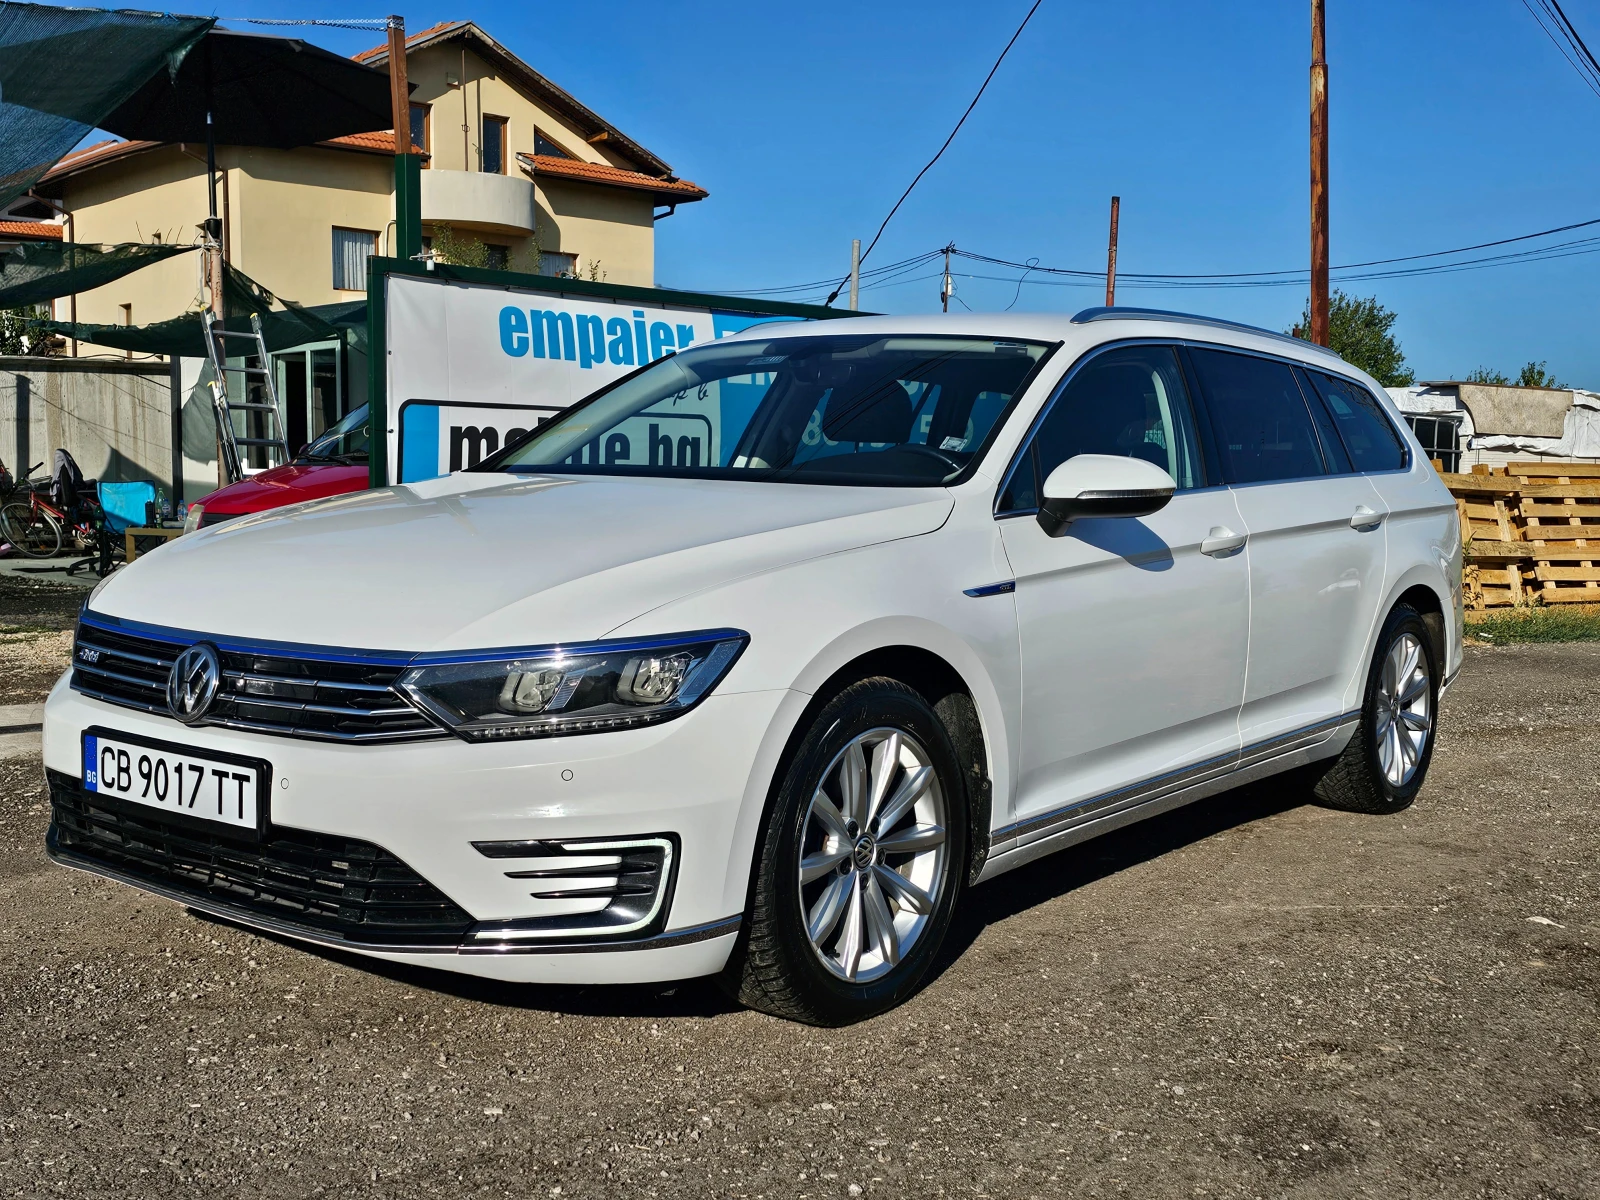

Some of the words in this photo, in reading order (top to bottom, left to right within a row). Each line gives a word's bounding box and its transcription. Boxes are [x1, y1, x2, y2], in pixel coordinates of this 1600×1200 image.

[499, 305, 695, 369] empaier
[86, 770, 97, 784] BG
[101, 746, 131, 793] CB
[138, 755, 204, 809] 9017
[212, 768, 251, 820] TT
